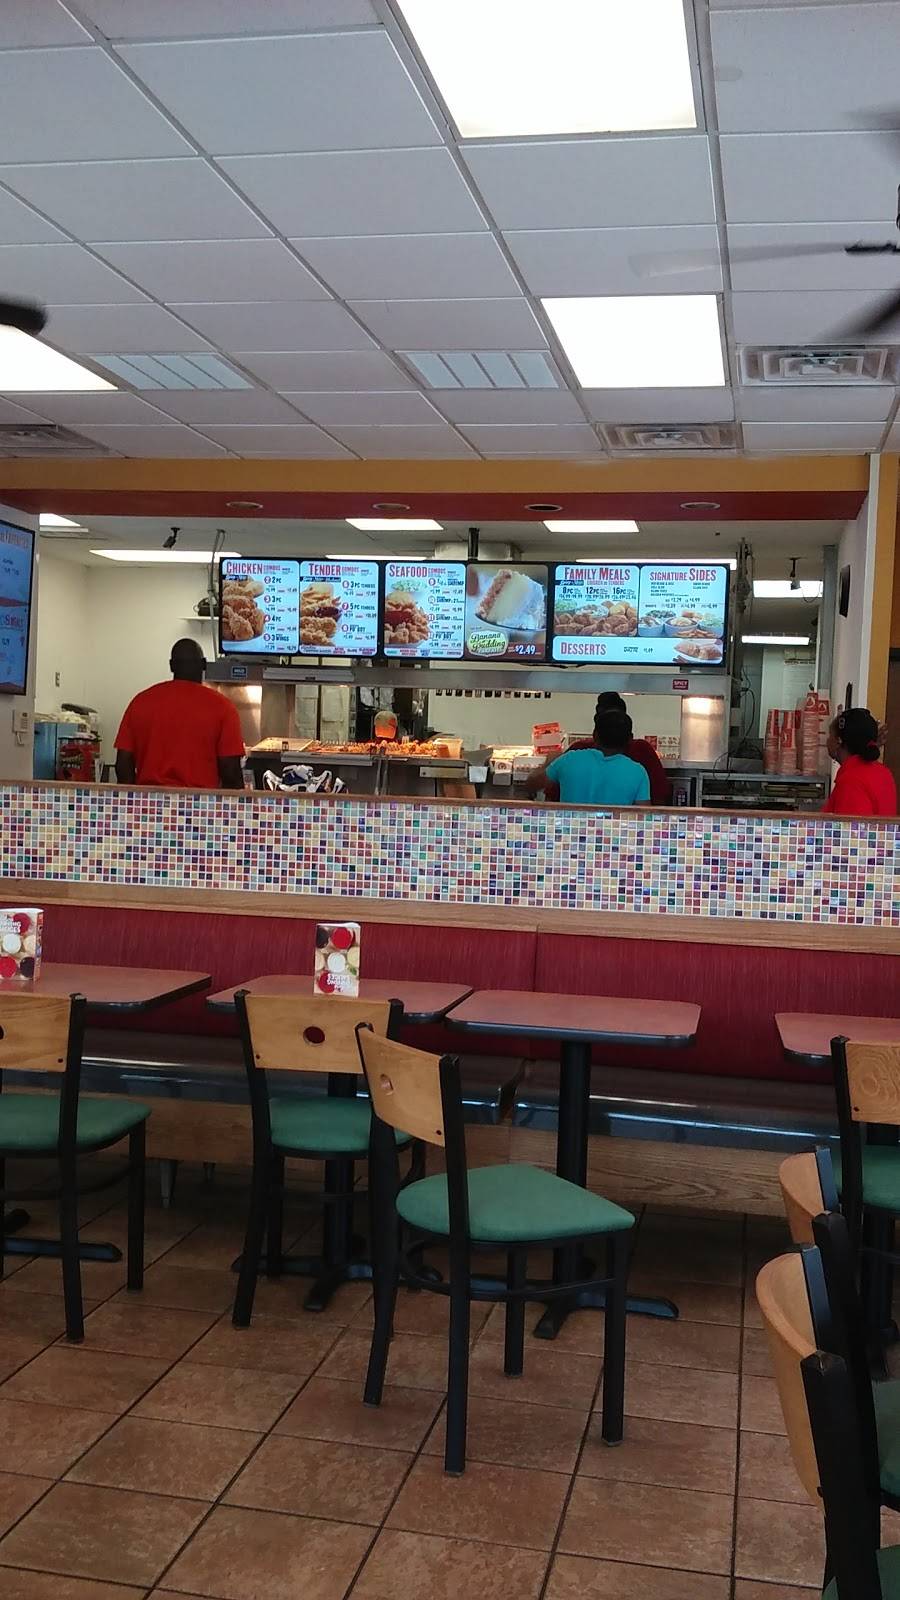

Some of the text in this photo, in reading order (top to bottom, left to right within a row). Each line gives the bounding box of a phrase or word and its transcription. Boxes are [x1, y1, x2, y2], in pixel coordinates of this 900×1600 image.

[226, 562, 263, 575] CHICKEN
[308, 563, 341, 576] TENDER
[389, 564, 428, 577] SEAFOOD
[565, 567, 631, 581] FAMILY MEALS
[650, 568, 716, 581] SIGNATURE SIDES
[470, 633, 501, 643] Banana
[471, 640, 505, 652] Pudding
[515, 645, 536, 655] $2.49
[561, 642, 607, 655] DESSERTS
